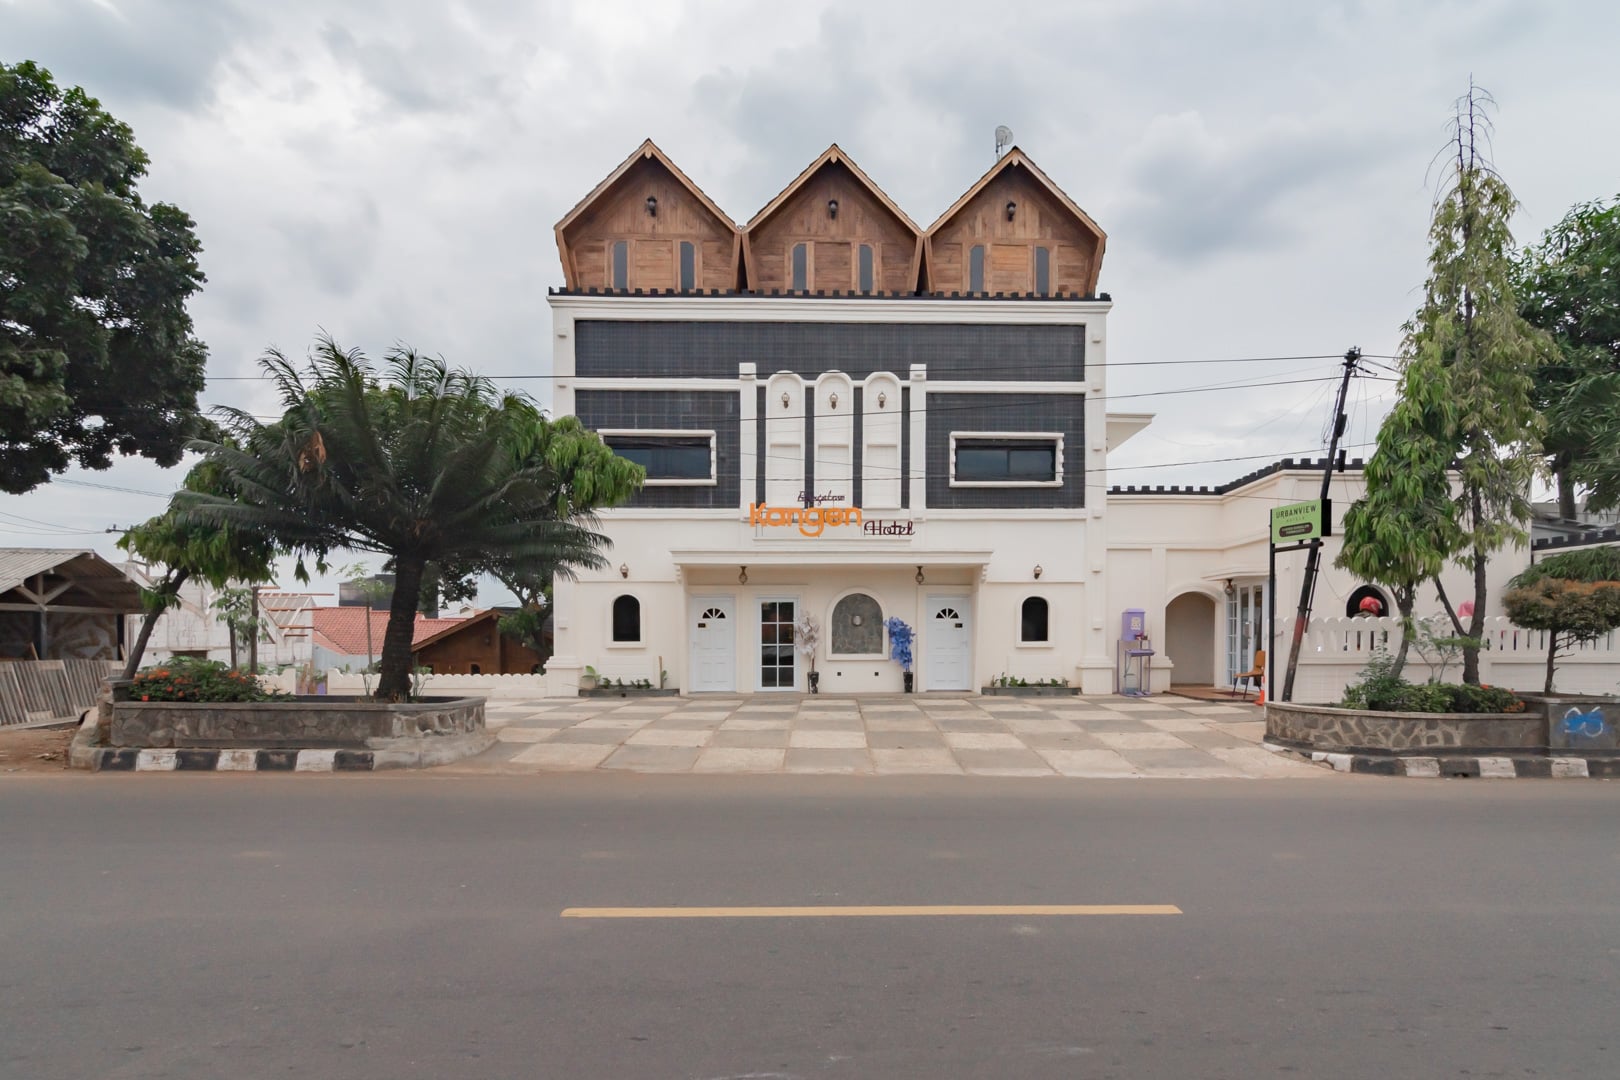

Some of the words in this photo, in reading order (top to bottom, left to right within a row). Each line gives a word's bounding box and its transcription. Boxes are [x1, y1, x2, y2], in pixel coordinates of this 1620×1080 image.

[750, 502, 862, 537] Kangen
[864, 520, 915, 535] Hotel
[1276, 504, 1316, 519] URBANVIEW
